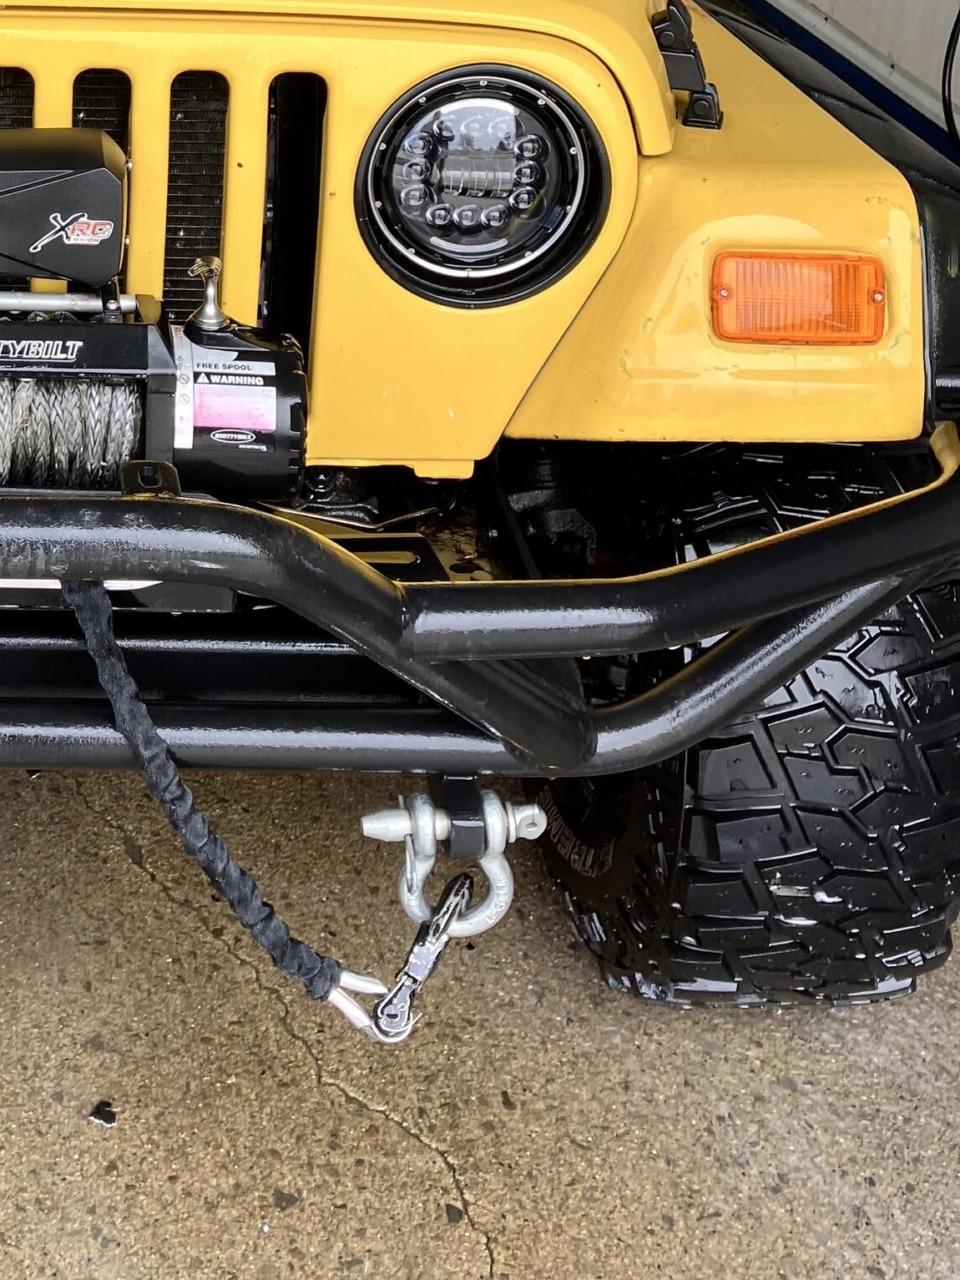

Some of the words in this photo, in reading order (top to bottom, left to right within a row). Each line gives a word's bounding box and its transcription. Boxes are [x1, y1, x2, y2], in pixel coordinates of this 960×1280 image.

[29, 213, 114, 252] XRC
[196, 362, 220, 370] FREE
[210, 374, 264, 386] WARNING
